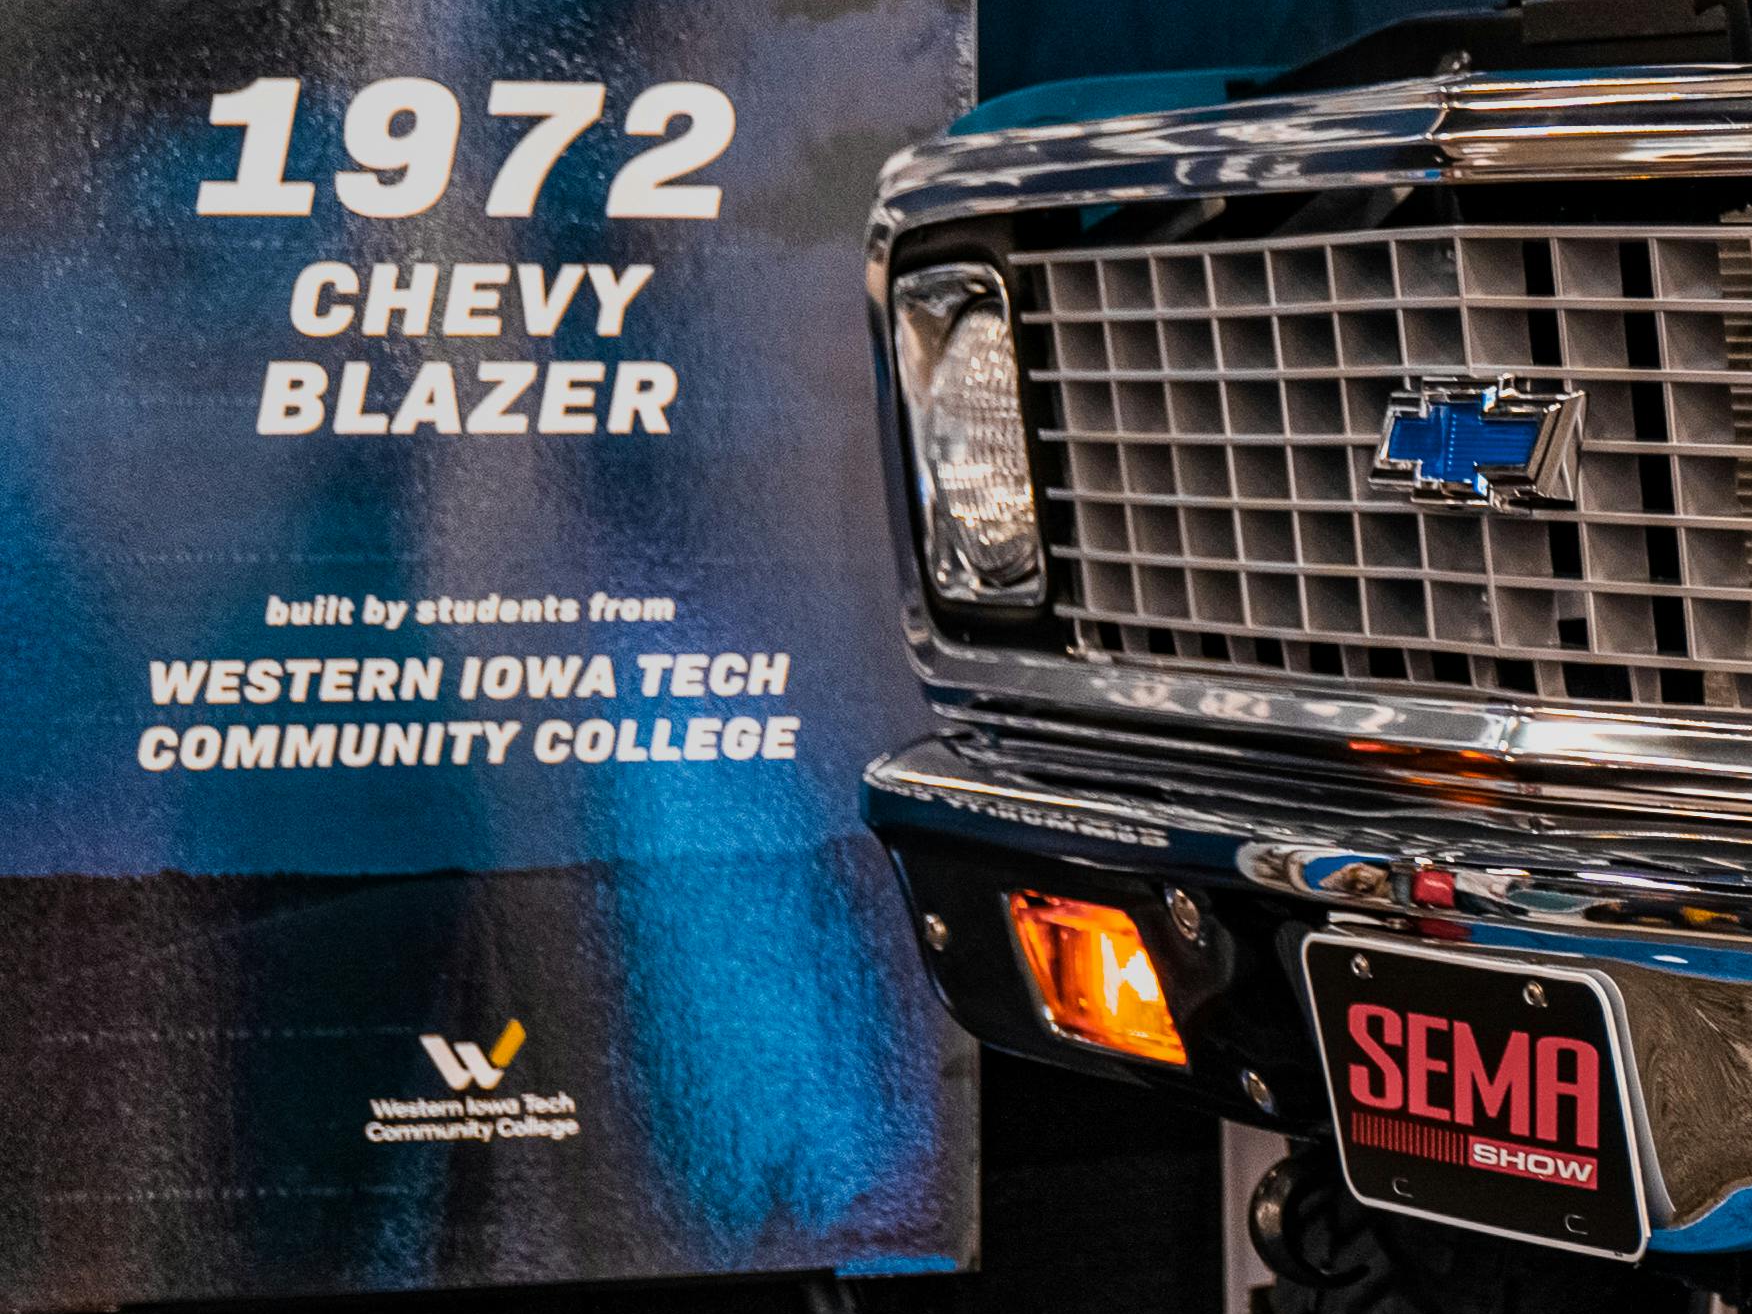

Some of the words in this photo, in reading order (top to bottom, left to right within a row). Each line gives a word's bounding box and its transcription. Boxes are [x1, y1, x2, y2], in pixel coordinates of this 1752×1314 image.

[195, 76, 737, 220] 1972
[289, 260, 655, 337] CHEVY
[255, 360, 679, 435] BLAZER
[264, 594, 355, 626] built
[362, 595, 407, 631] by
[415, 592, 580, 624] students
[588, 590, 676, 622] from
[148, 656, 443, 705] WESTERN
[459, 655, 617, 700] IOWA
[636, 652, 791, 697] TECH
[136, 720, 522, 773] COMMUNITY
[533, 716, 800, 765] COLLEGE
[1346, 1003, 1600, 1149] SEMA
[363, 1116, 494, 1143] Community
[496, 1114, 581, 1141] College
[368, 1095, 465, 1120] Western
[465, 1094, 520, 1116] Iowa
[520, 1090, 576, 1115] Tech
[1472, 1143, 1594, 1182] SHOW
